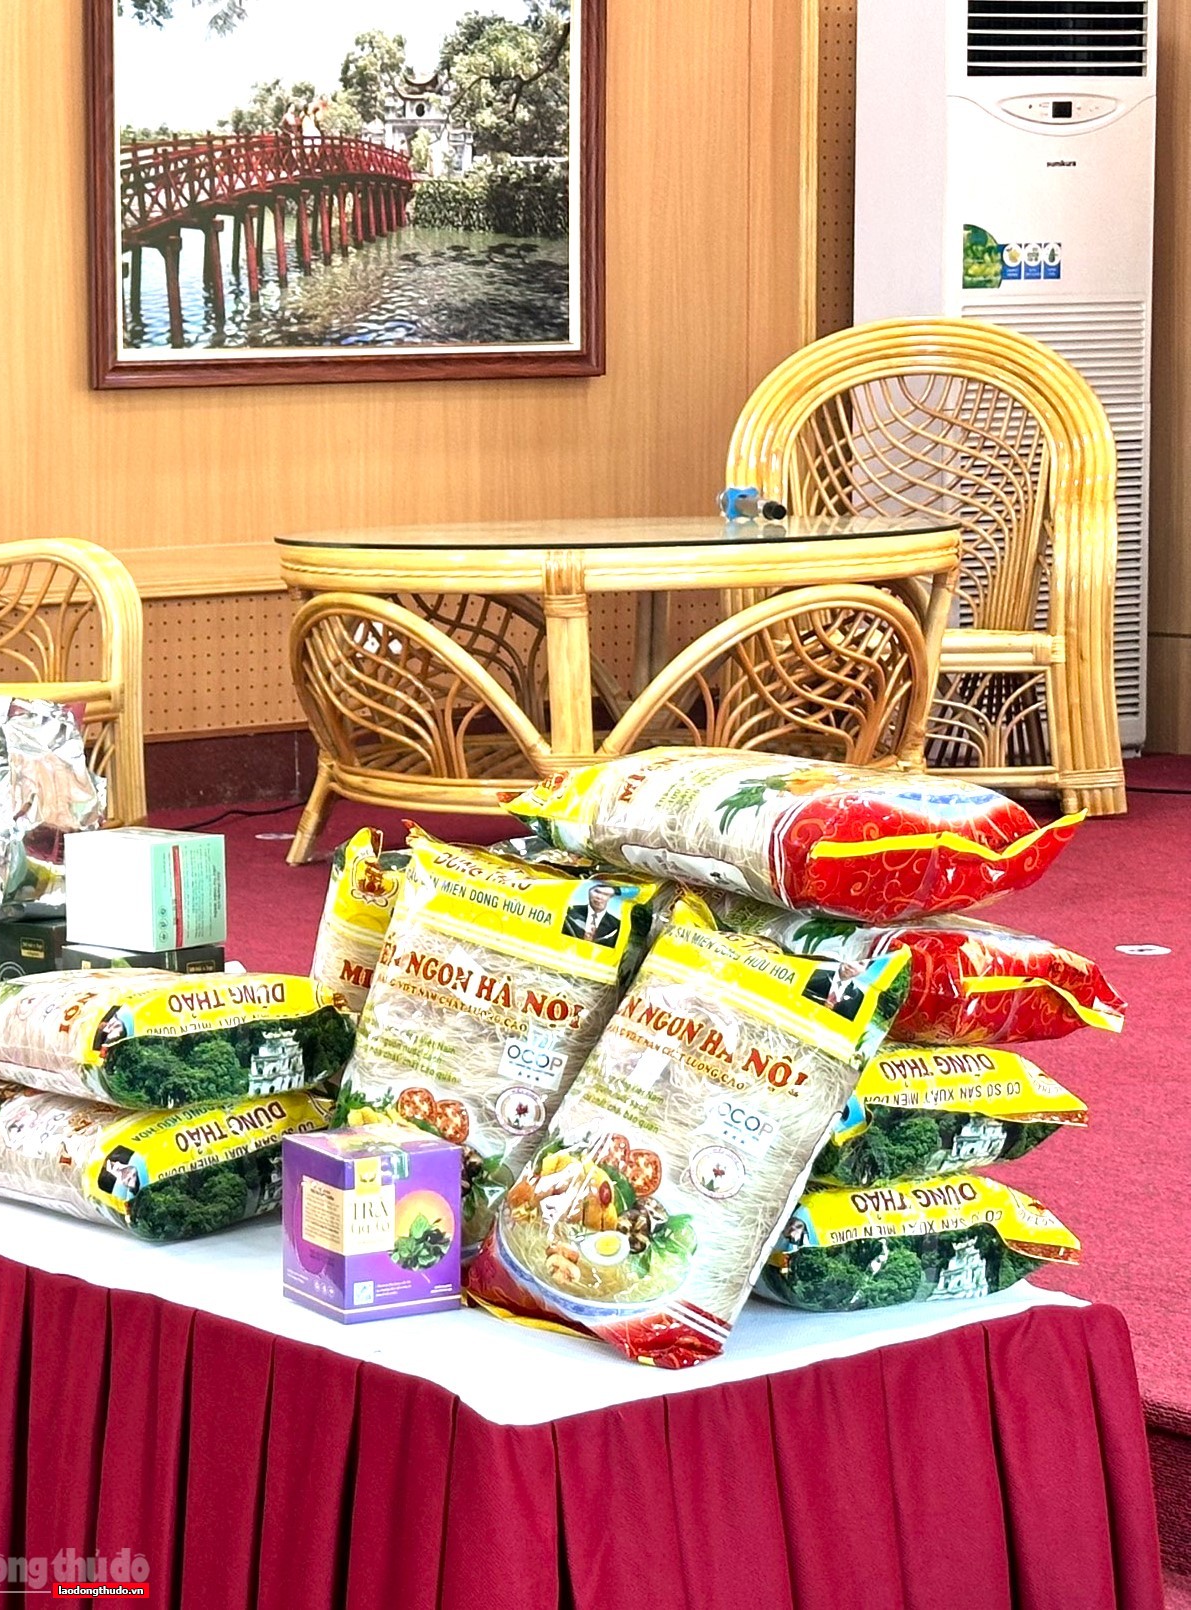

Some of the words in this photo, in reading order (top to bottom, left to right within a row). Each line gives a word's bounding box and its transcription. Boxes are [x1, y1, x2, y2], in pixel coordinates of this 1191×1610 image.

[468, 888, 499, 908] DONG
[339, 959, 375, 989] MI
[405, 951, 473, 993] NGON
[475, 975, 511, 1008] HÀ
[168, 989, 225, 1018] THẢO
[507, 1044, 563, 1071] OCOP
[880, 1057, 934, 1088] THẢO
[936, 1053, 996, 1077] DŨNG
[227, 1100, 287, 1135] DŨNG
[717, 1101, 774, 1136] OCOP
[176, 1121, 228, 1154] THẢO
